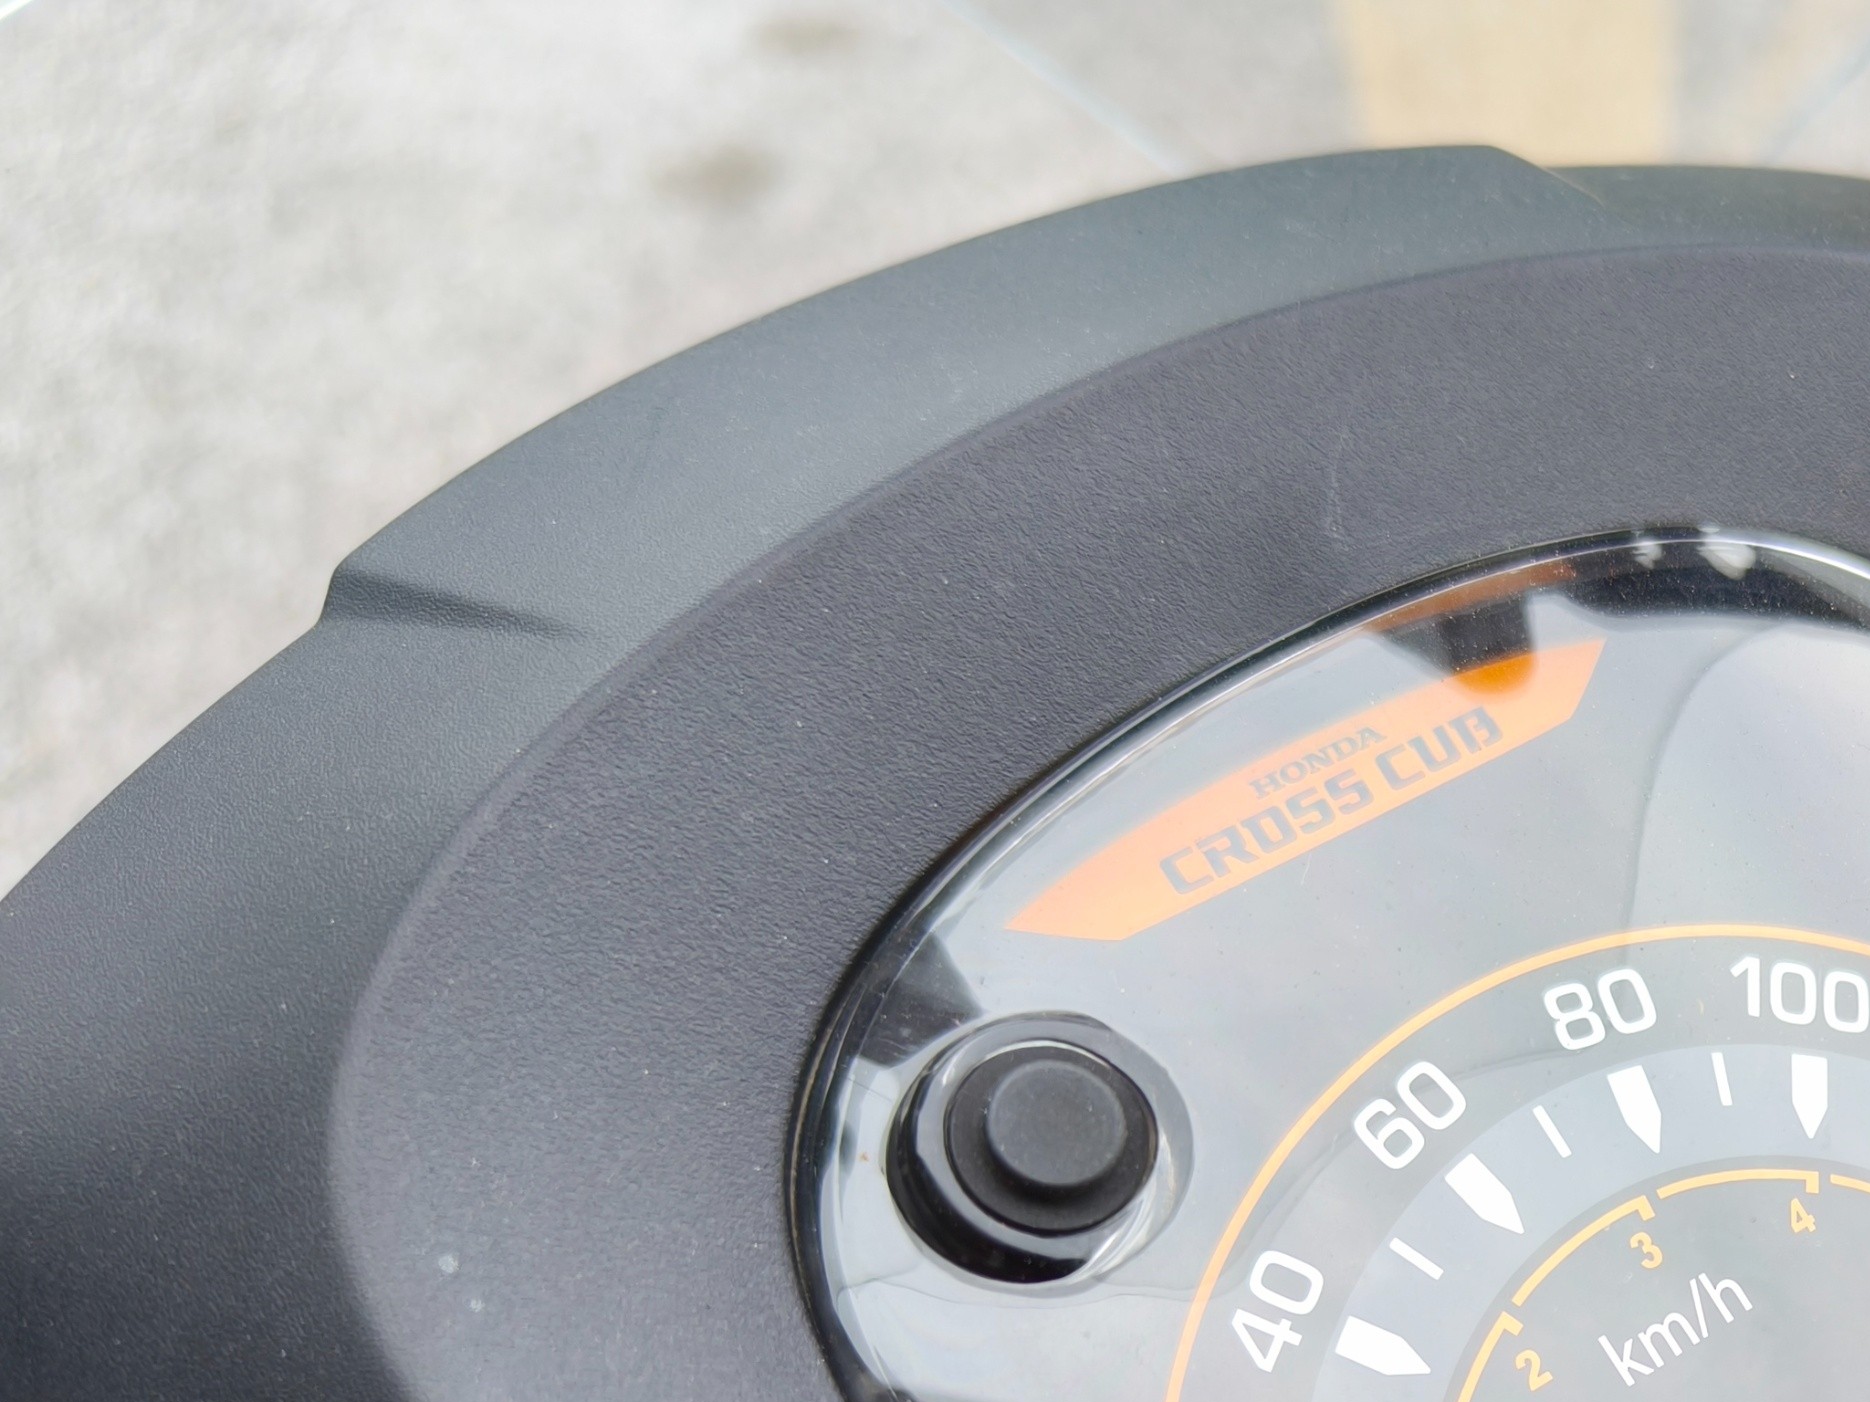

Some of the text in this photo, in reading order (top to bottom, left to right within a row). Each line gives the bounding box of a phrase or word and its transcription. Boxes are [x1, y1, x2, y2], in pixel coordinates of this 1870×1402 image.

[1159, 706, 1503, 894] CROSS CUB
[1249, 726, 1387, 800] HONDA
[1543, 968, 1657, 1050] 80
[1730, 956, 1870, 1033] 100
[1354, 1061, 1466, 1169] 60
[1630, 1232, 1663, 1269] 3
[1790, 1198, 1816, 1233] 4
[1232, 1250, 1324, 1373] 40
[1598, 1272, 1754, 1387] km/h
[1515, 1349, 1553, 1391] 2
